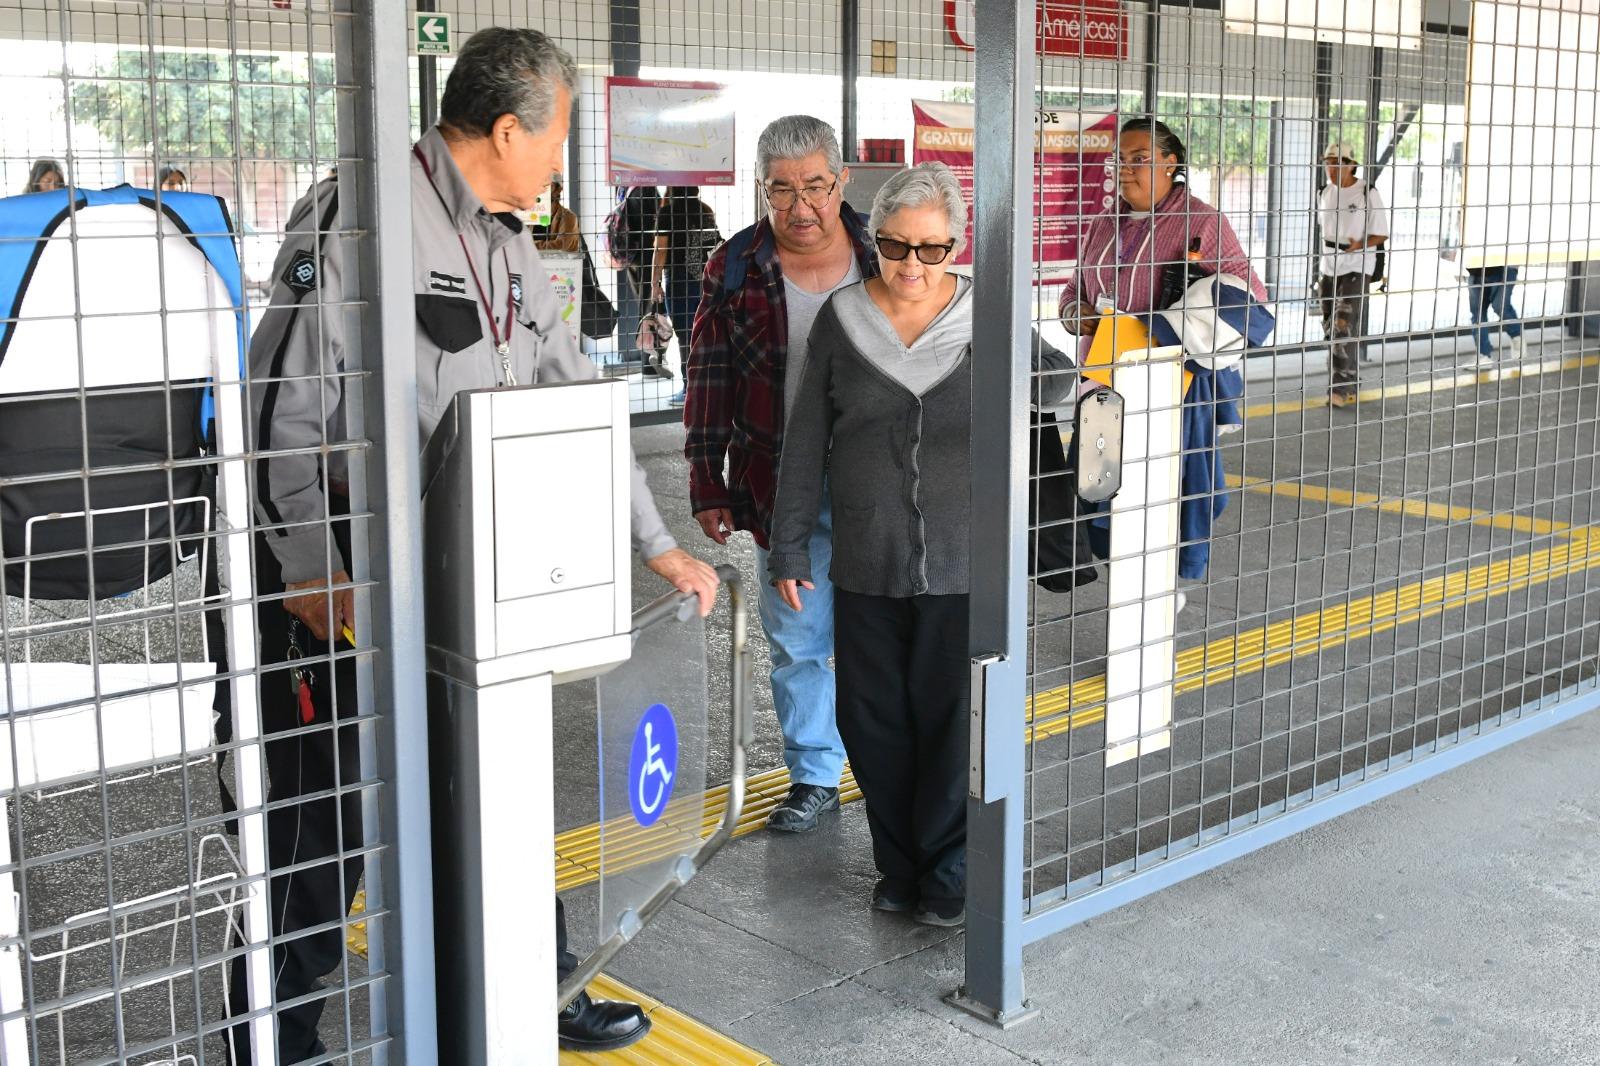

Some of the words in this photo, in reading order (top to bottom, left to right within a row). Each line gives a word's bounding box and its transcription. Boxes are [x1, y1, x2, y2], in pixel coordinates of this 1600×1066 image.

[1037, 11, 1117, 40] Améicas
[922, 131, 974, 147] GRATUI
[1034, 133, 1110, 148] RANSBORDO
